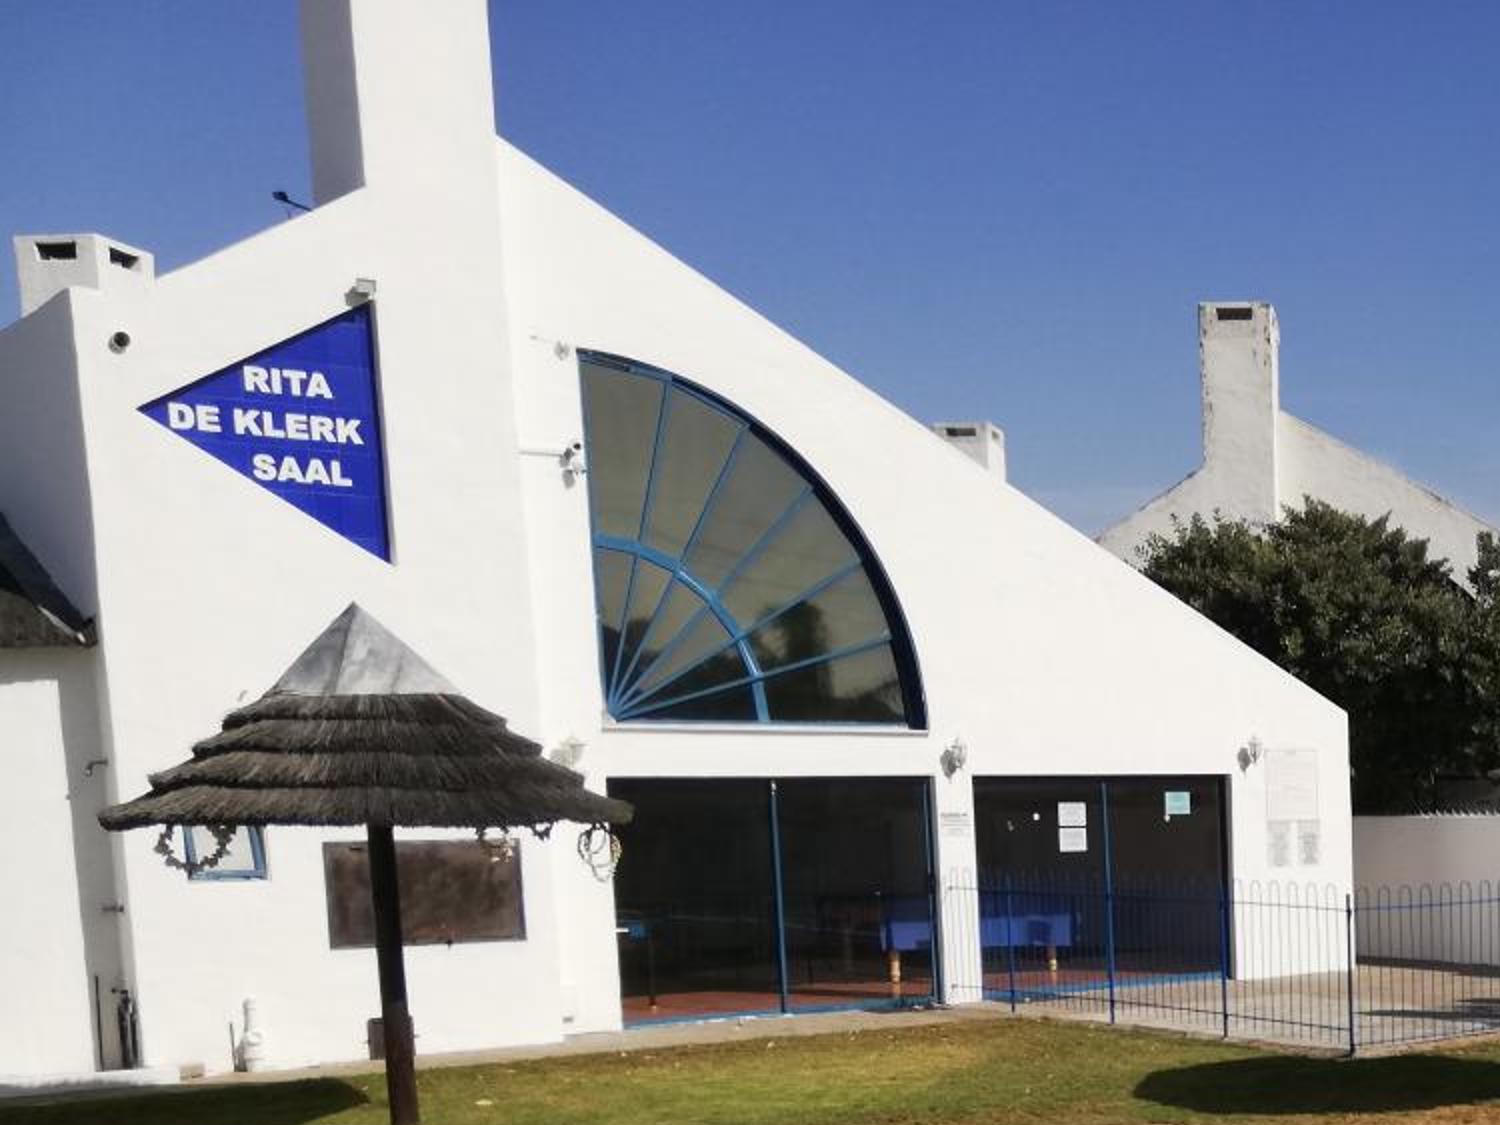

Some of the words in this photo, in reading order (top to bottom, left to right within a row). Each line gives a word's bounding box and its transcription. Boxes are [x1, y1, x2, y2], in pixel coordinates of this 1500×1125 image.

[243, 365, 333, 399] RITA
[167, 402, 222, 433] DE
[233, 408, 364, 445] KLERK
[252, 453, 353, 487] SAAL
